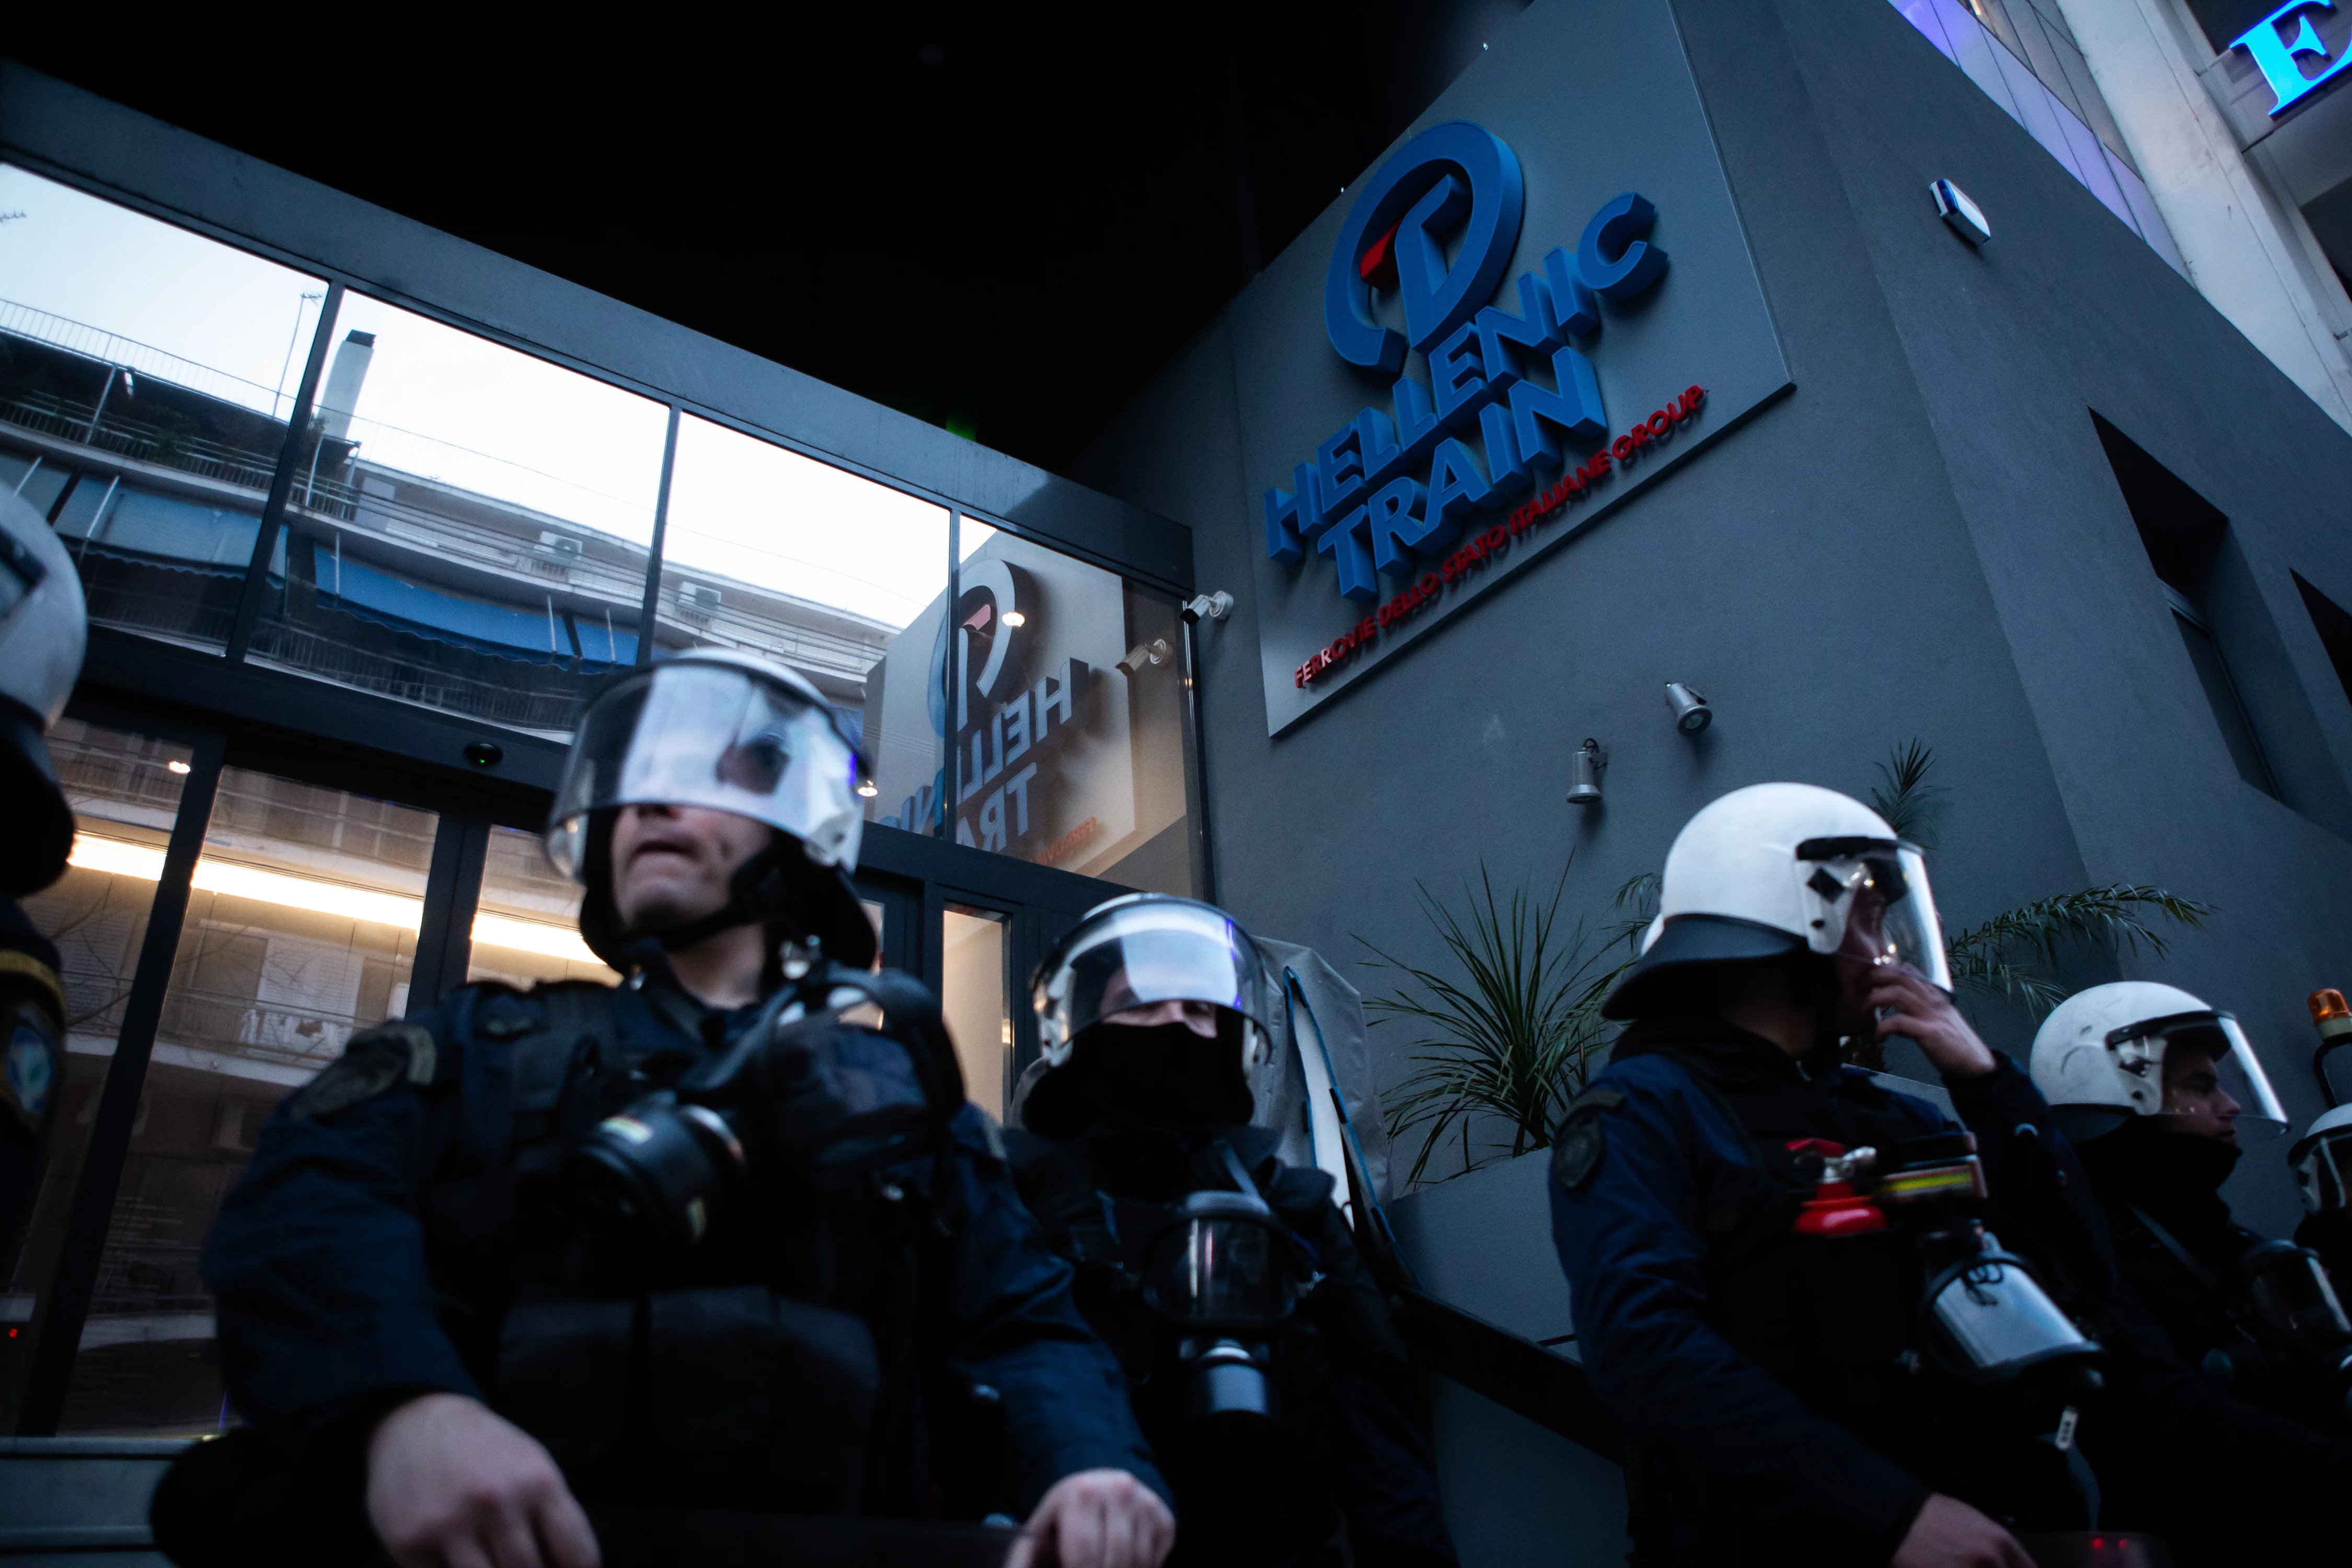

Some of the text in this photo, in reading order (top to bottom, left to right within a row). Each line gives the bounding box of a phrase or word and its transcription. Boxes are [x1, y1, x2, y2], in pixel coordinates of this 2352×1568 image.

[1262, 192, 1667, 566] HELLENIC
[1318, 345, 1607, 602] TRAIN
[1294, 385, 1704, 688] FERROVIE DELLO STATO ITALIANE GROUP
